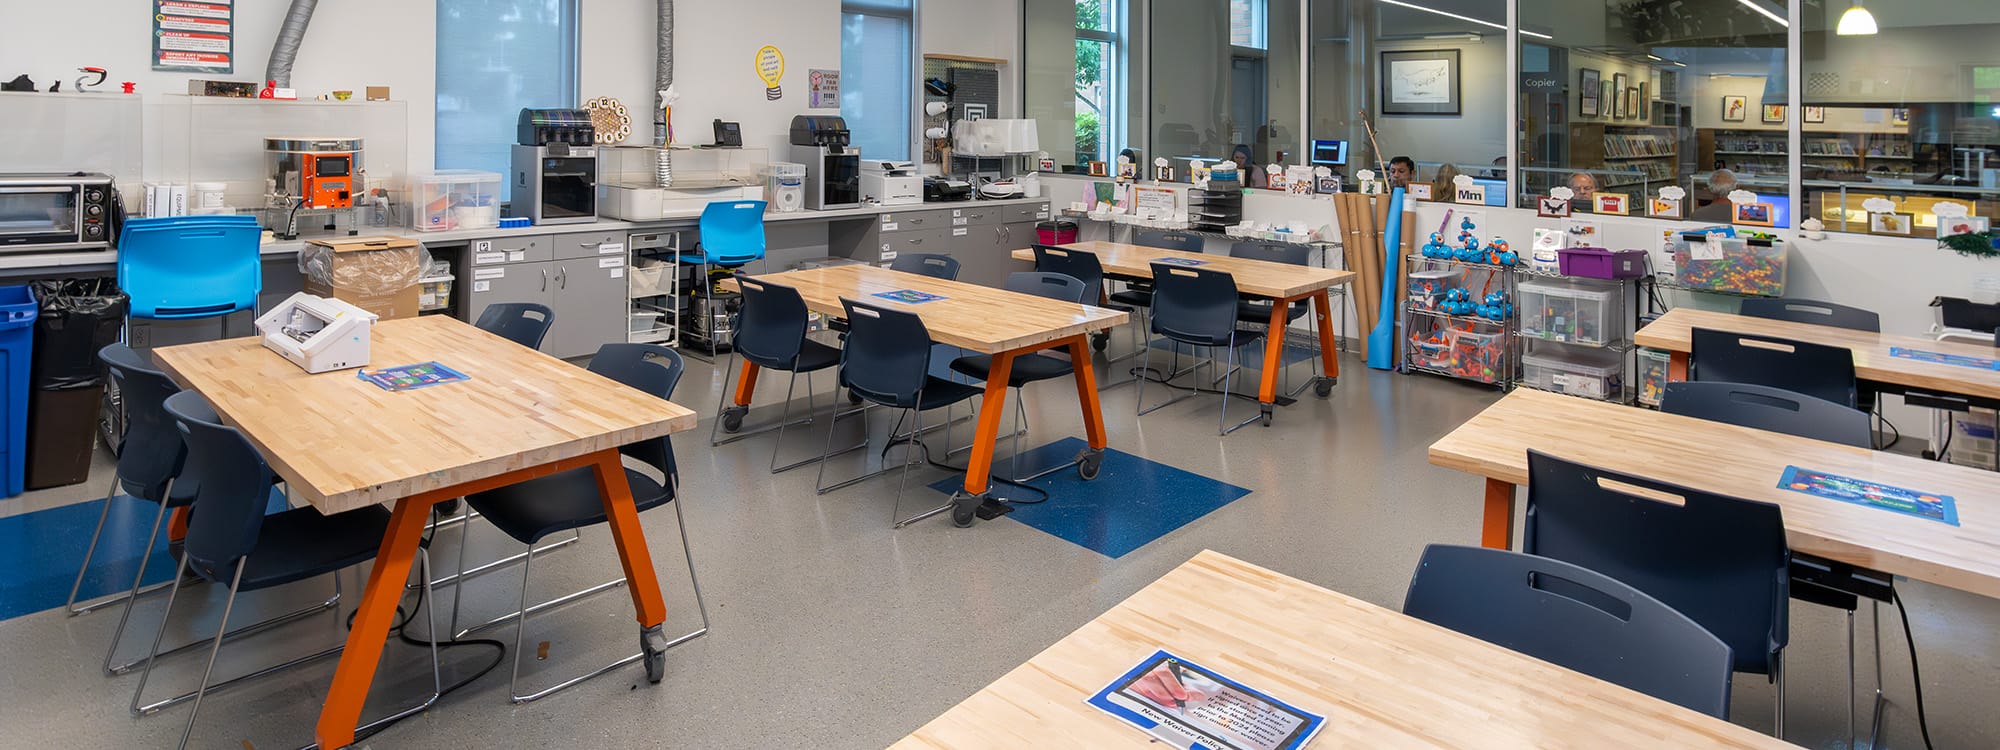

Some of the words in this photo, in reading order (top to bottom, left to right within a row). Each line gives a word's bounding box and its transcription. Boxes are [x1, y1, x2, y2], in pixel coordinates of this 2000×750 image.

[1525, 78, 1557, 88] Copier
[601, 98, 608, 106] 12
[1458, 190, 1482, 200] Mm
[1213, 700, 1228, 709] you
[1229, 706, 1257, 721] started
[1257, 719, 1285, 735] coming
[1215, 695, 1240, 706] signed
[1265, 716, 1285, 728] year.
[1222, 690, 1251, 705] Waivers
[1252, 703, 1272, 714] need
[1141, 708, 1161, 720] New
[1163, 719, 1197, 737] Waiver
[1196, 735, 1225, 750] Policy
[1193, 710, 1209, 720] sign
[1208, 718, 1239, 733] another
[1240, 732, 1270, 749] waiver.
[1197, 706, 1217, 716] prior
[1227, 719, 1249, 731] 2024
[1248, 729, 1275, 744] please
[1216, 706, 1229, 714] the
[1229, 712, 1276, 737] Makerspace
